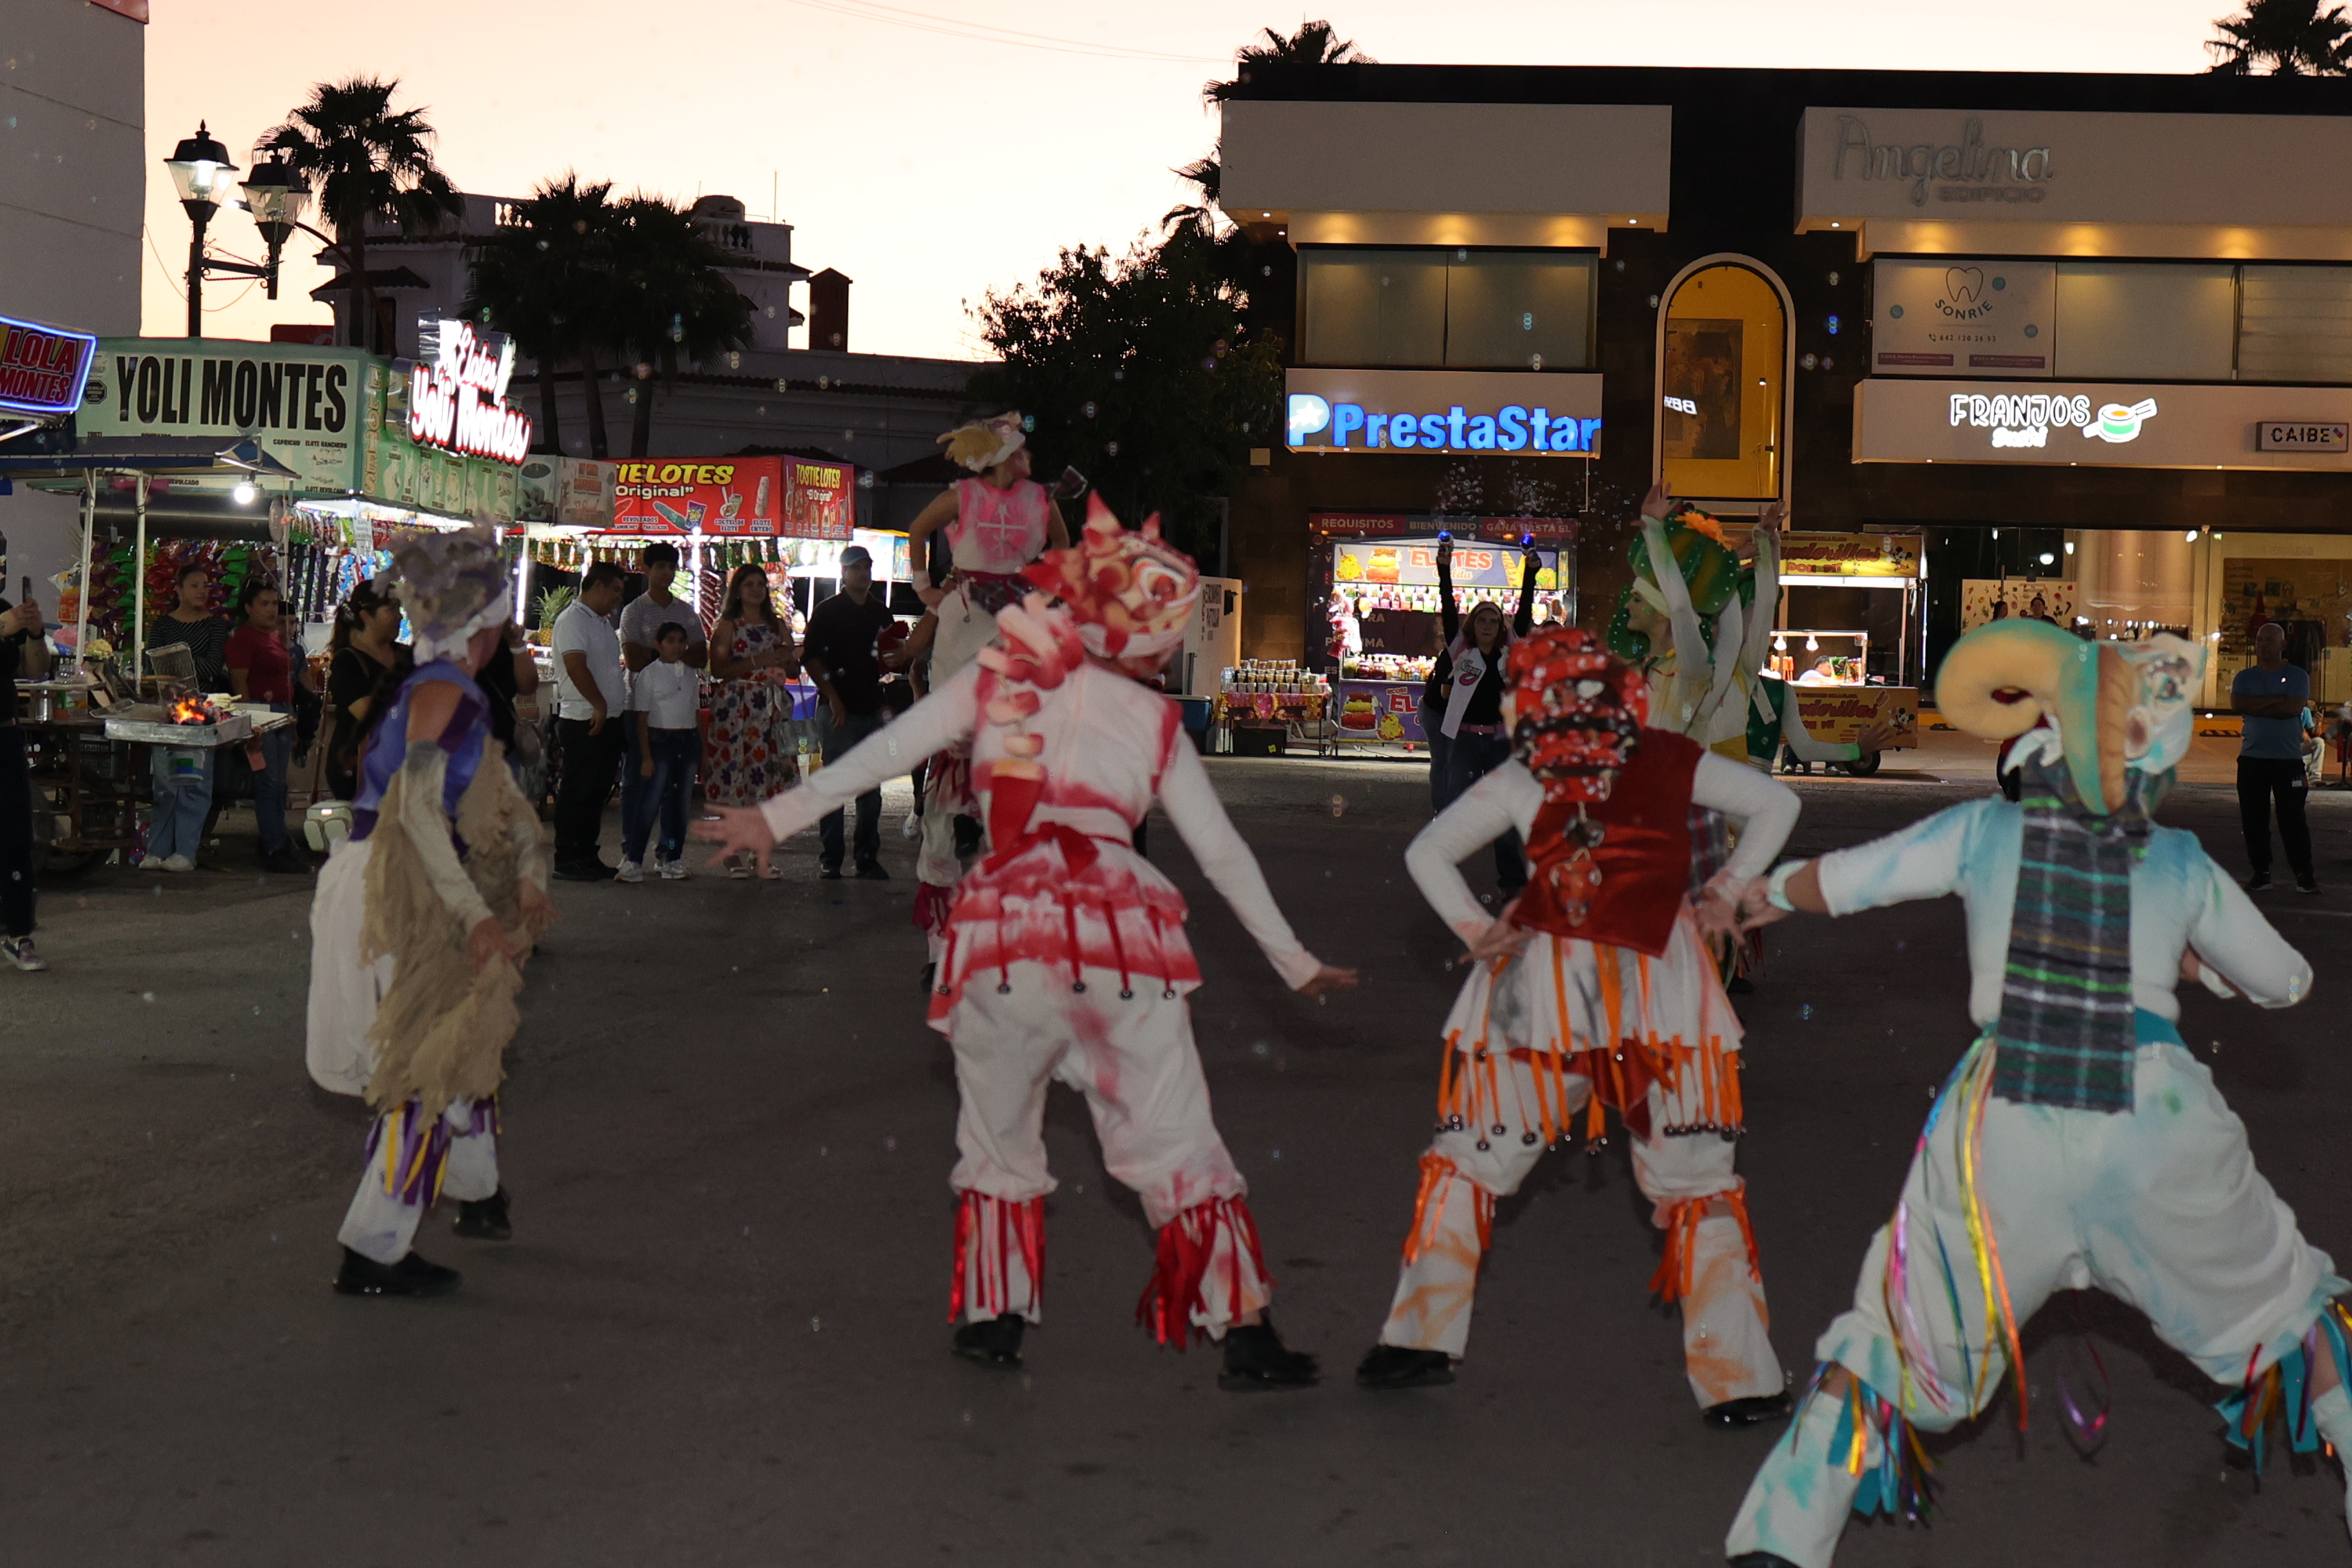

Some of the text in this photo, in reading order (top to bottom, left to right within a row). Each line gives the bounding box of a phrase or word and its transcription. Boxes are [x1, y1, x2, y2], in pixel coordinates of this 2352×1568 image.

[1834, 115, 2054, 206] Angelina
[1937, 186, 2045, 202] EDIFICIO
[1934, 299, 1993, 320] SONRIE
[3, 329, 77, 375] LOLA
[455, 322, 498, 393] Elotes
[0, 366, 71, 405] MONTES
[116, 355, 347, 433] YOLI MONTES
[1950, 394, 2090, 427] FRANJOS
[455, 383, 532, 466] Montes
[1333, 404, 1601, 451] PrestaStar
[2271, 427, 2330, 442] CAIBE
[616, 464, 734, 484] IELOTES
[796, 464, 841, 489] TOSTIELOTES
[1322, 518, 1394, 529] REQUISITOS
[1409, 521, 1477, 531] BIENVENIDO
[1487, 522, 1517, 531] GANA
[1410, 550, 1492, 569] ELTES
